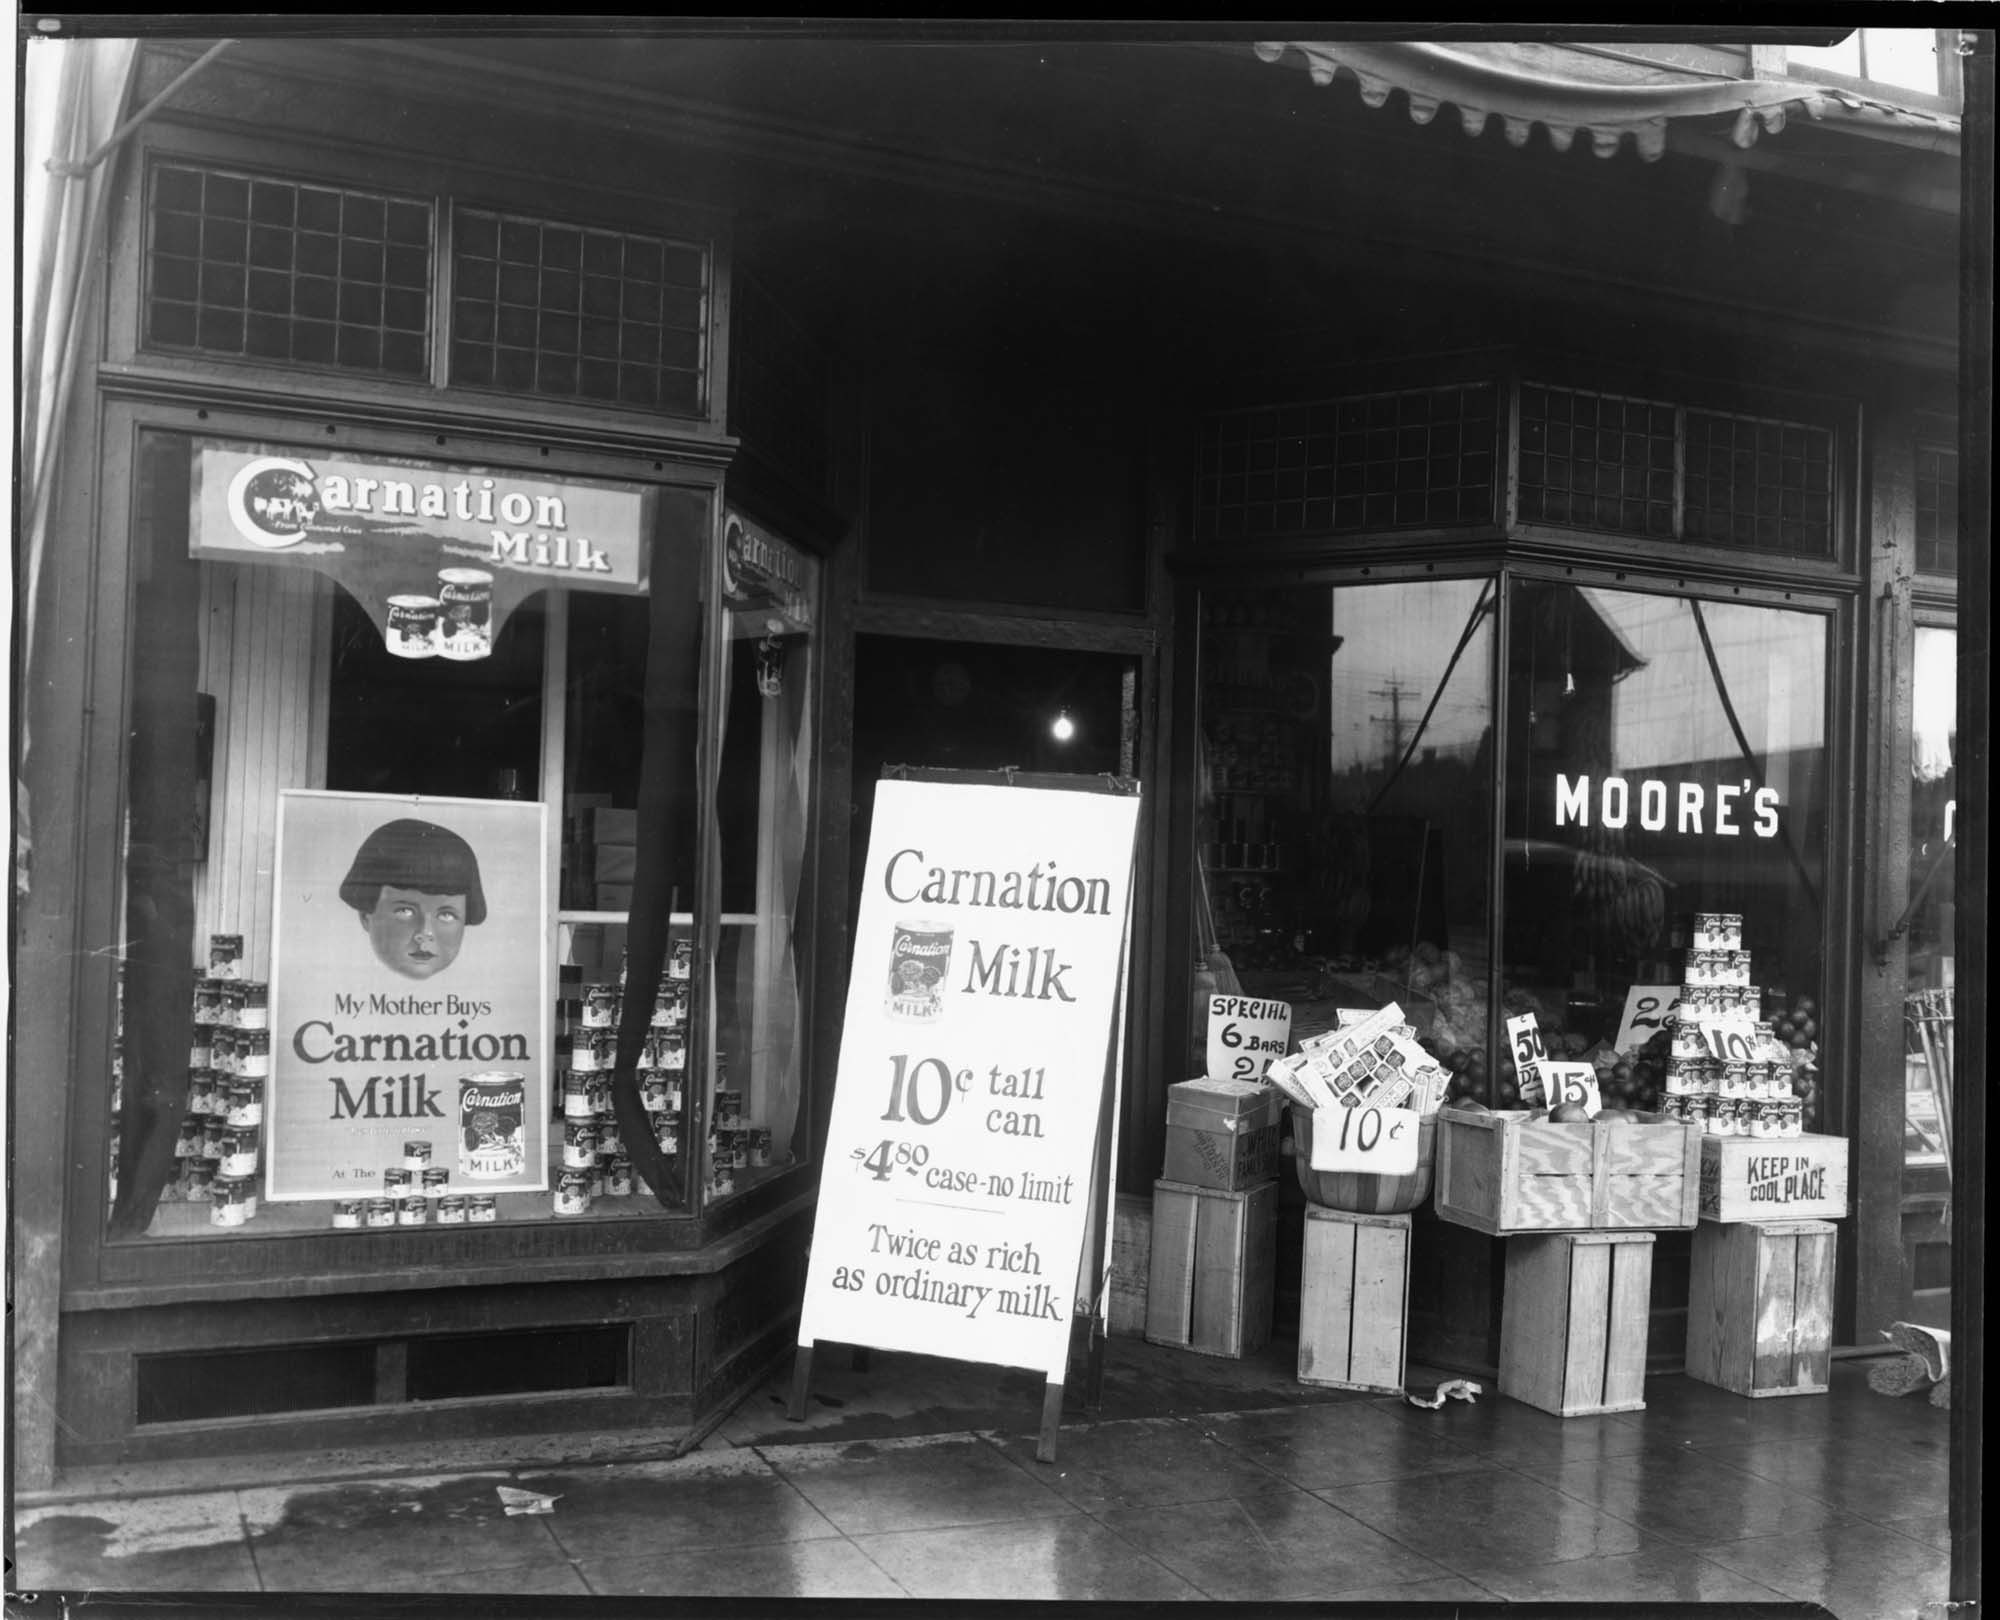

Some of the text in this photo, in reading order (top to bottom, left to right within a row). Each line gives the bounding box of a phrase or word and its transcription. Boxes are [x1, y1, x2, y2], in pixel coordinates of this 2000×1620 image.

[228, 457, 567, 548] Carnation
[489, 529, 612, 573] Milk
[1555, 774, 1779, 838] MOORE'S
[884, 848, 1112, 916] Carnation
[895, 934, 951, 957] Carnation
[961, 939, 1077, 1003] Milk
[335, 994, 492, 1019] My Mother Buys
[892, 1000, 933, 1017] MILK
[1211, 997, 1288, 1021] SPECIAL
[292, 1019, 531, 1064] Carnation
[1221, 1022, 1285, 1055] 6 BARS
[1516, 1027, 1545, 1063] 50
[328, 1073, 446, 1120] Milk
[462, 1087, 522, 1112] Carnation
[988, 1064, 1045, 1101] tall
[986, 1107, 1045, 1138] can
[353, 1168, 376, 1179] The
[470, 1160, 513, 1172] MILK
[1747, 1156, 1809, 1184] KEEP IN
[1018, 1171, 1074, 1205] limit
[1750, 1167, 1826, 1203] COOL PLACE
[868, 1223, 1042, 1276] Twice as rich
[832, 1264, 1064, 1322] as ordinary milk
